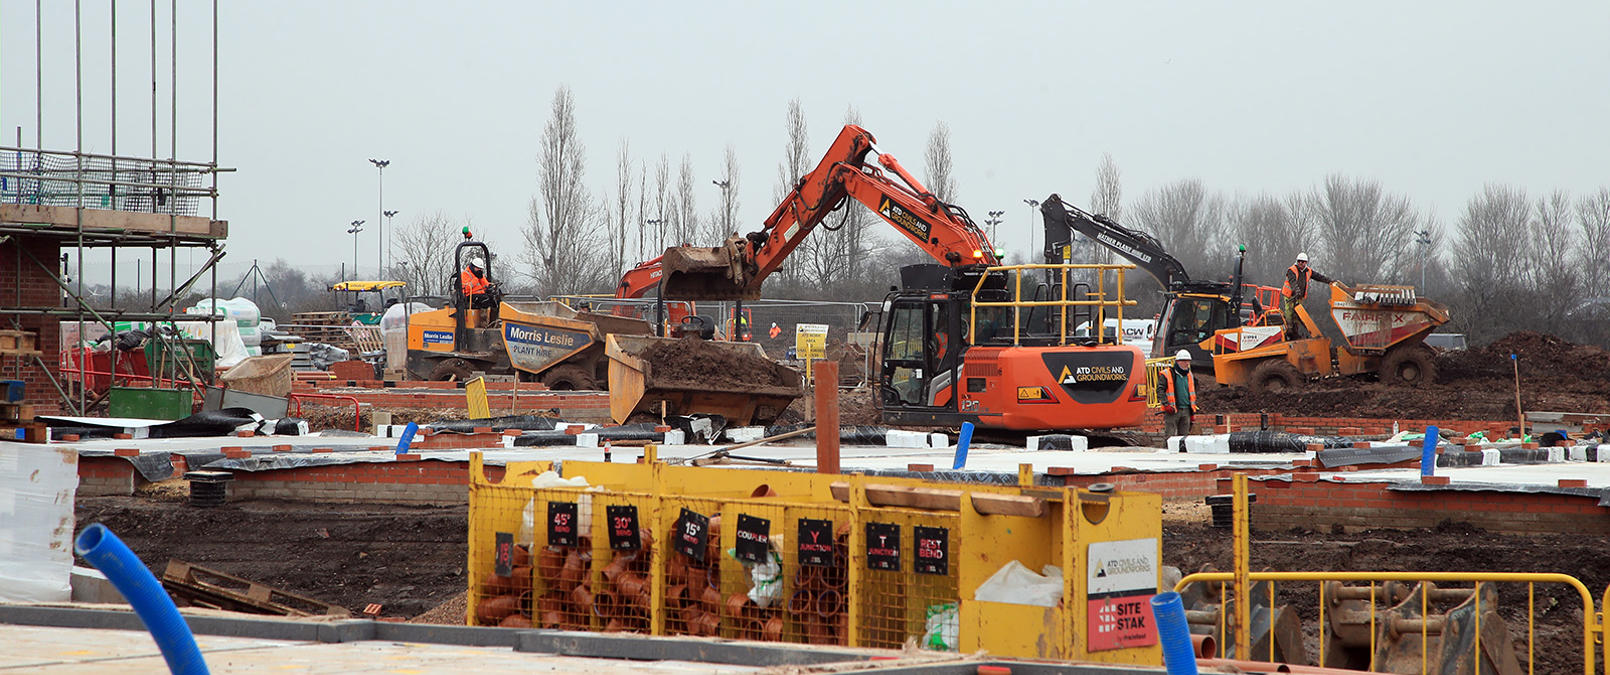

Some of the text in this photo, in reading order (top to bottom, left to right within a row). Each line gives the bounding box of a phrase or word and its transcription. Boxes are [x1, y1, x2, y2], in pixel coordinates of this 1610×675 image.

[892, 206, 927, 232] ATD CIVILS AND
[1116, 240, 1132, 253] PLANT
[1342, 312, 1404, 323] FAIRFX
[510, 327, 574, 347] Morris Leslie
[513, 345, 552, 358] PLANT HIRE
[1091, 366, 1111, 374] CIVILS
[1111, 366, 1124, 374] AND
[554, 513, 571, 526] 45°
[614, 517, 632, 529] 30°
[615, 529, 633, 537] BEND
[685, 521, 701, 536] 15°
[737, 530, 768, 544] COUPLER
[810, 530, 820, 543] Y
[879, 535, 887, 548] T
[800, 544, 832, 552] JUNCTION
[920, 538, 942, 549] REST
[868, 548, 899, 557] JUNCTION
[919, 548, 943, 559] BEND
[1117, 602, 1141, 616] SITE
[1117, 616, 1145, 631] STAK
